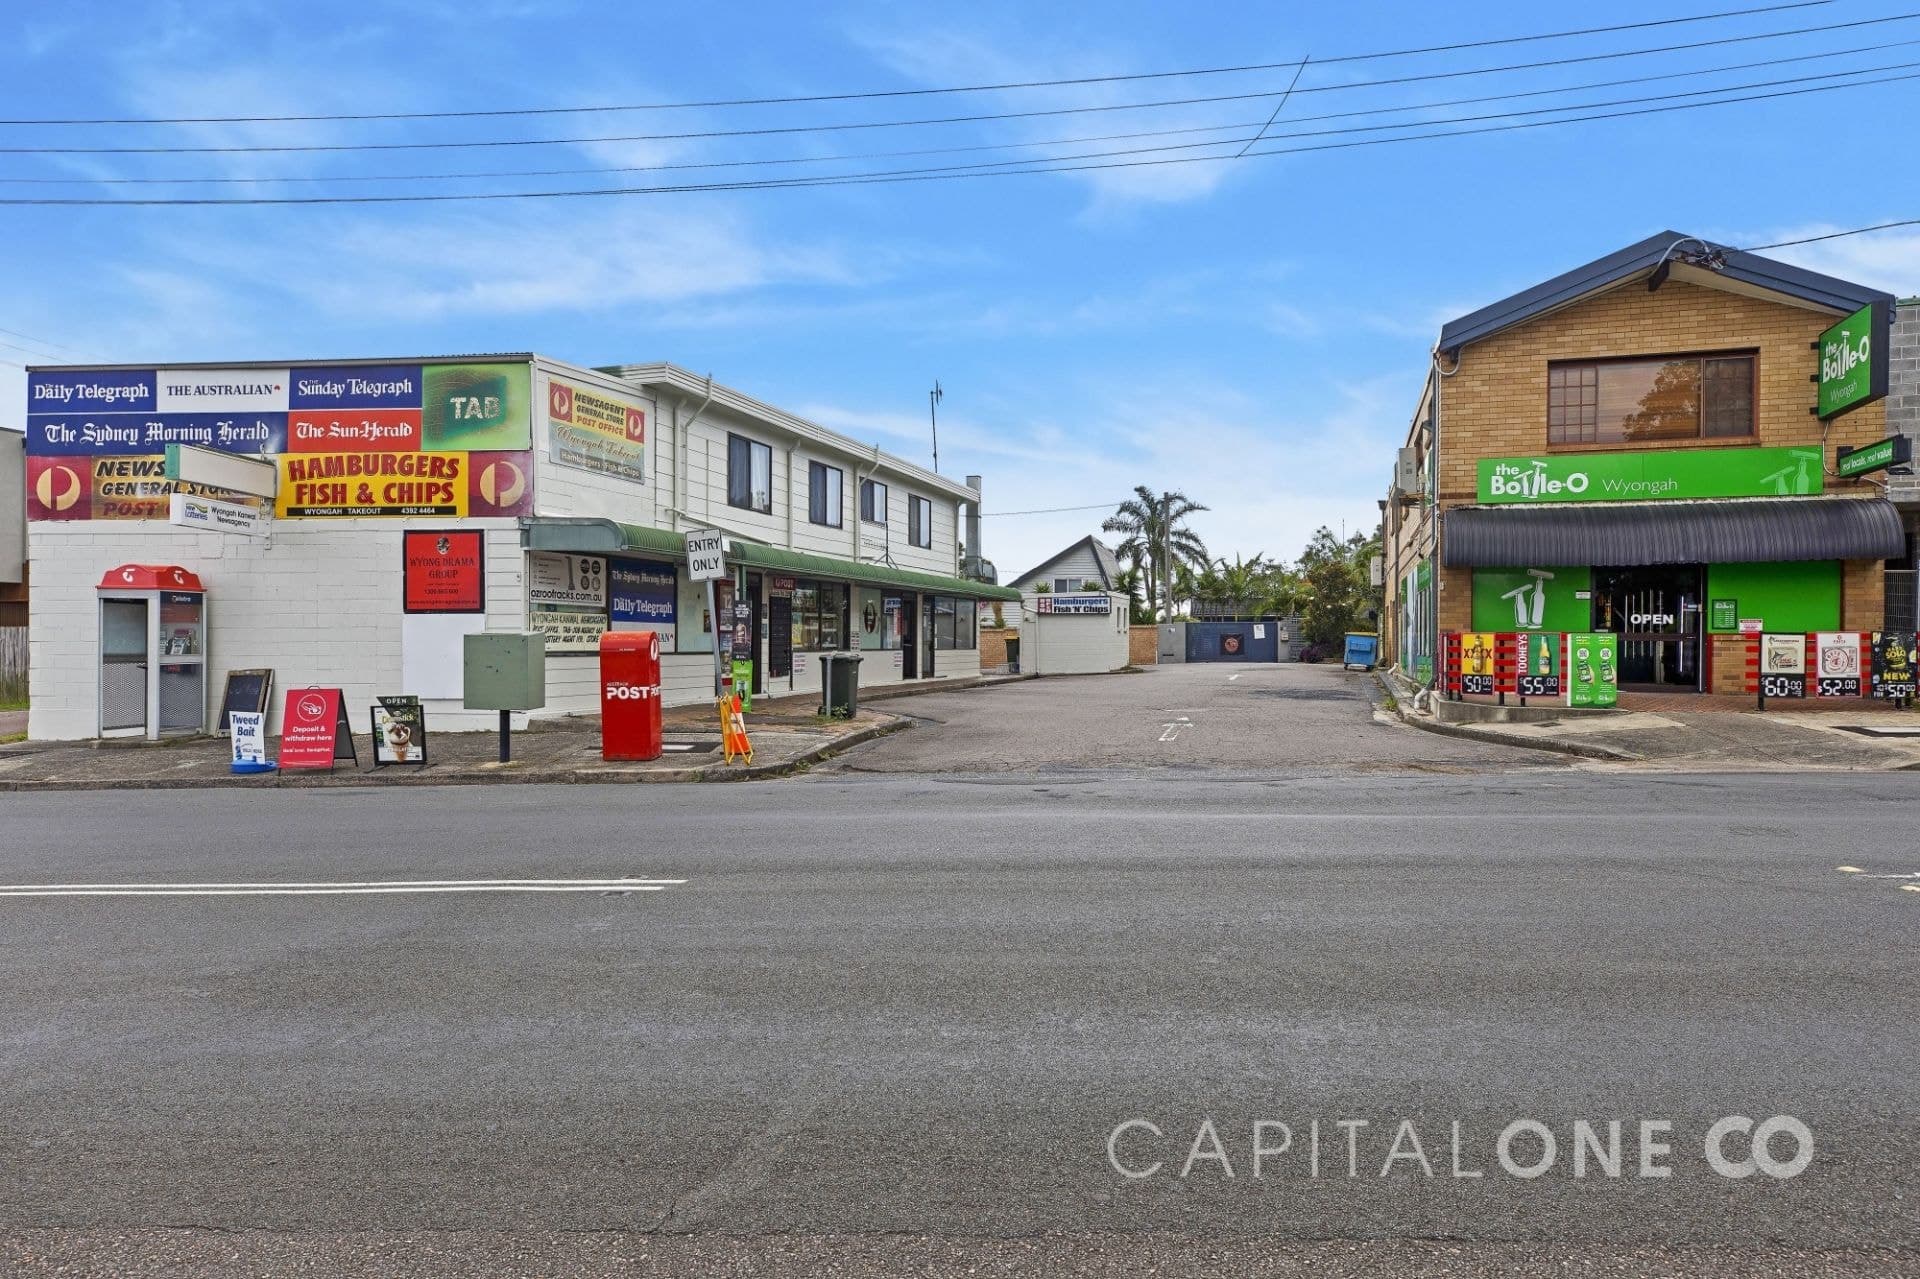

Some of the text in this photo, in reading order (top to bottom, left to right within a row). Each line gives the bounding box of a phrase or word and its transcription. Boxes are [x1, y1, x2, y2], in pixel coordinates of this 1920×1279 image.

[1826, 342, 1837, 358] the
[34, 383, 150, 402] Daily Telegraph
[167, 384, 273, 396] THE AUSTRALIAN
[298, 378, 412, 398] Sunday Telegraph
[450, 396, 500, 419] TAB
[574, 392, 626, 416] NEWSAGENT
[576, 404, 604, 420] GENERAL
[296, 420, 413, 441] The Sun-Herald
[577, 416, 624, 436] POST OFFICE
[44, 421, 269, 446] The Sydney Morning Herald
[96, 460, 165, 477] NEWS
[288, 454, 460, 482] HAMBURGERS
[1496, 463, 1520, 476] the
[102, 482, 184, 496] GENERAL
[1602, 478, 1678, 495] Wyongah
[295, 482, 455, 506] FISH & CHIPS
[103, 502, 158, 516] POST
[211, 506, 236, 517] Wyongah
[217, 516, 250, 528] Newsagency
[689, 538, 720, 552] ENTRY
[410, 557, 440, 568] WYONG
[693, 558, 720, 572] ONLY
[429, 570, 458, 578] GROUP
[530, 589, 602, 602] ozroofracks.com.au
[614, 598, 672, 618] Daily Telegraph
[1630, 614, 1674, 624] OPEN
[1518, 634, 1528, 673] TOOHEYS
[1884, 672, 1910, 680] NEW
[607, 686, 650, 700] POST
[232, 714, 260, 725] Tweed
[238, 726, 255, 736] Bait
